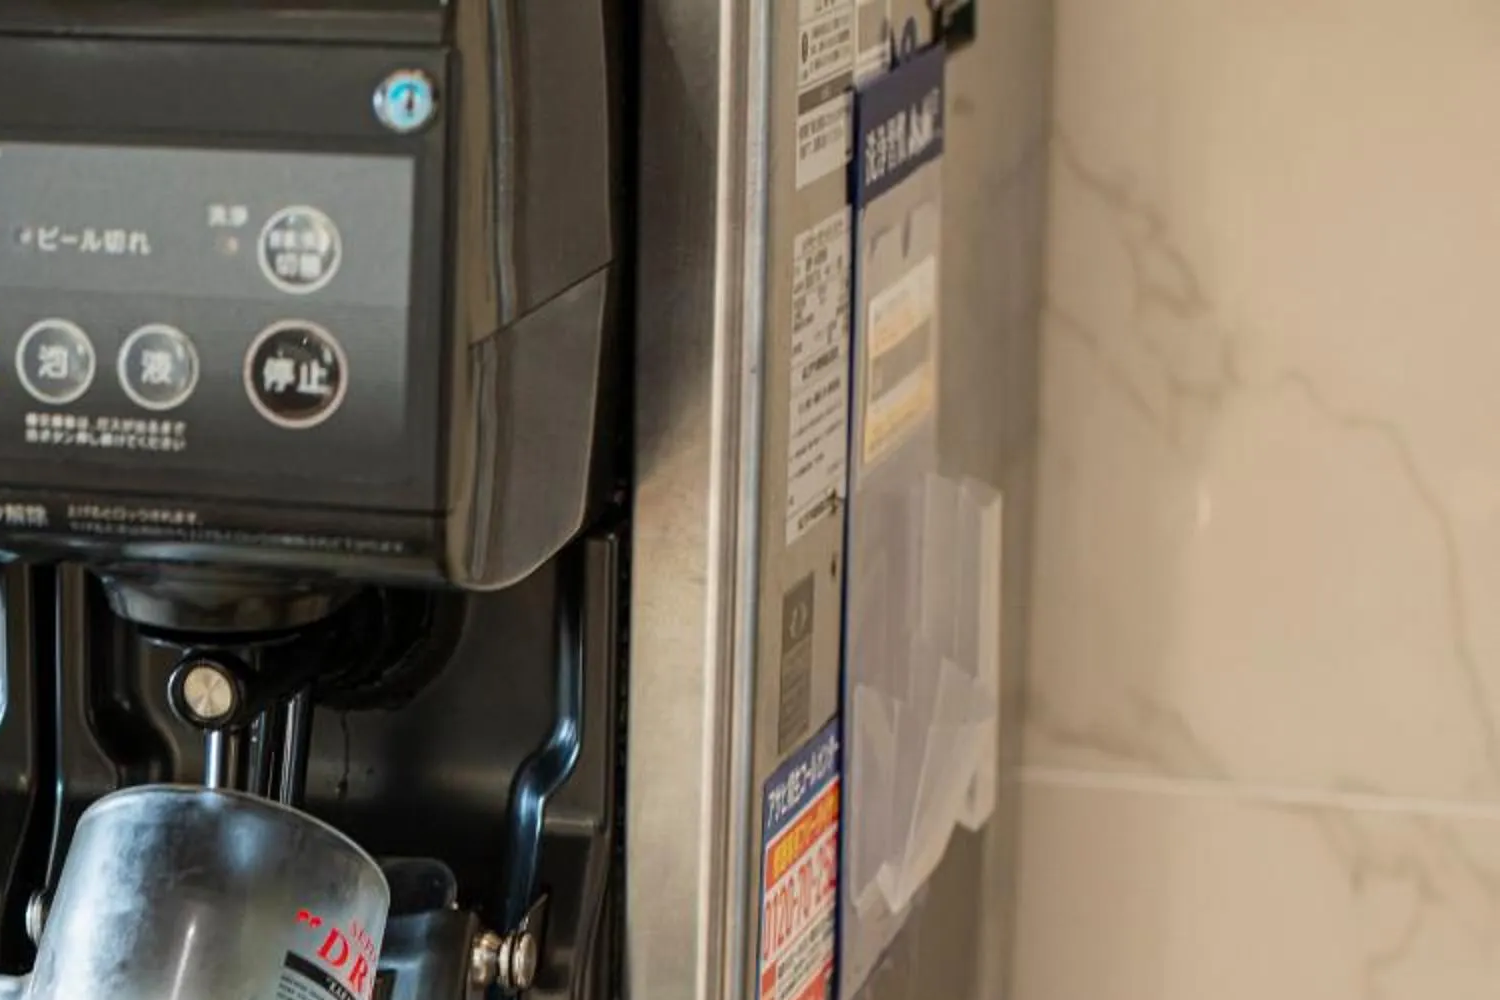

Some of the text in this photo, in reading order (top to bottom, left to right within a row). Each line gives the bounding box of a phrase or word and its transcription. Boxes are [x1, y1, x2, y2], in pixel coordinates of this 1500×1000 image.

[37, 226, 152, 256] ビール切れ
[38, 344, 69, 380] 泡
[262, 350, 334, 394] 停止
